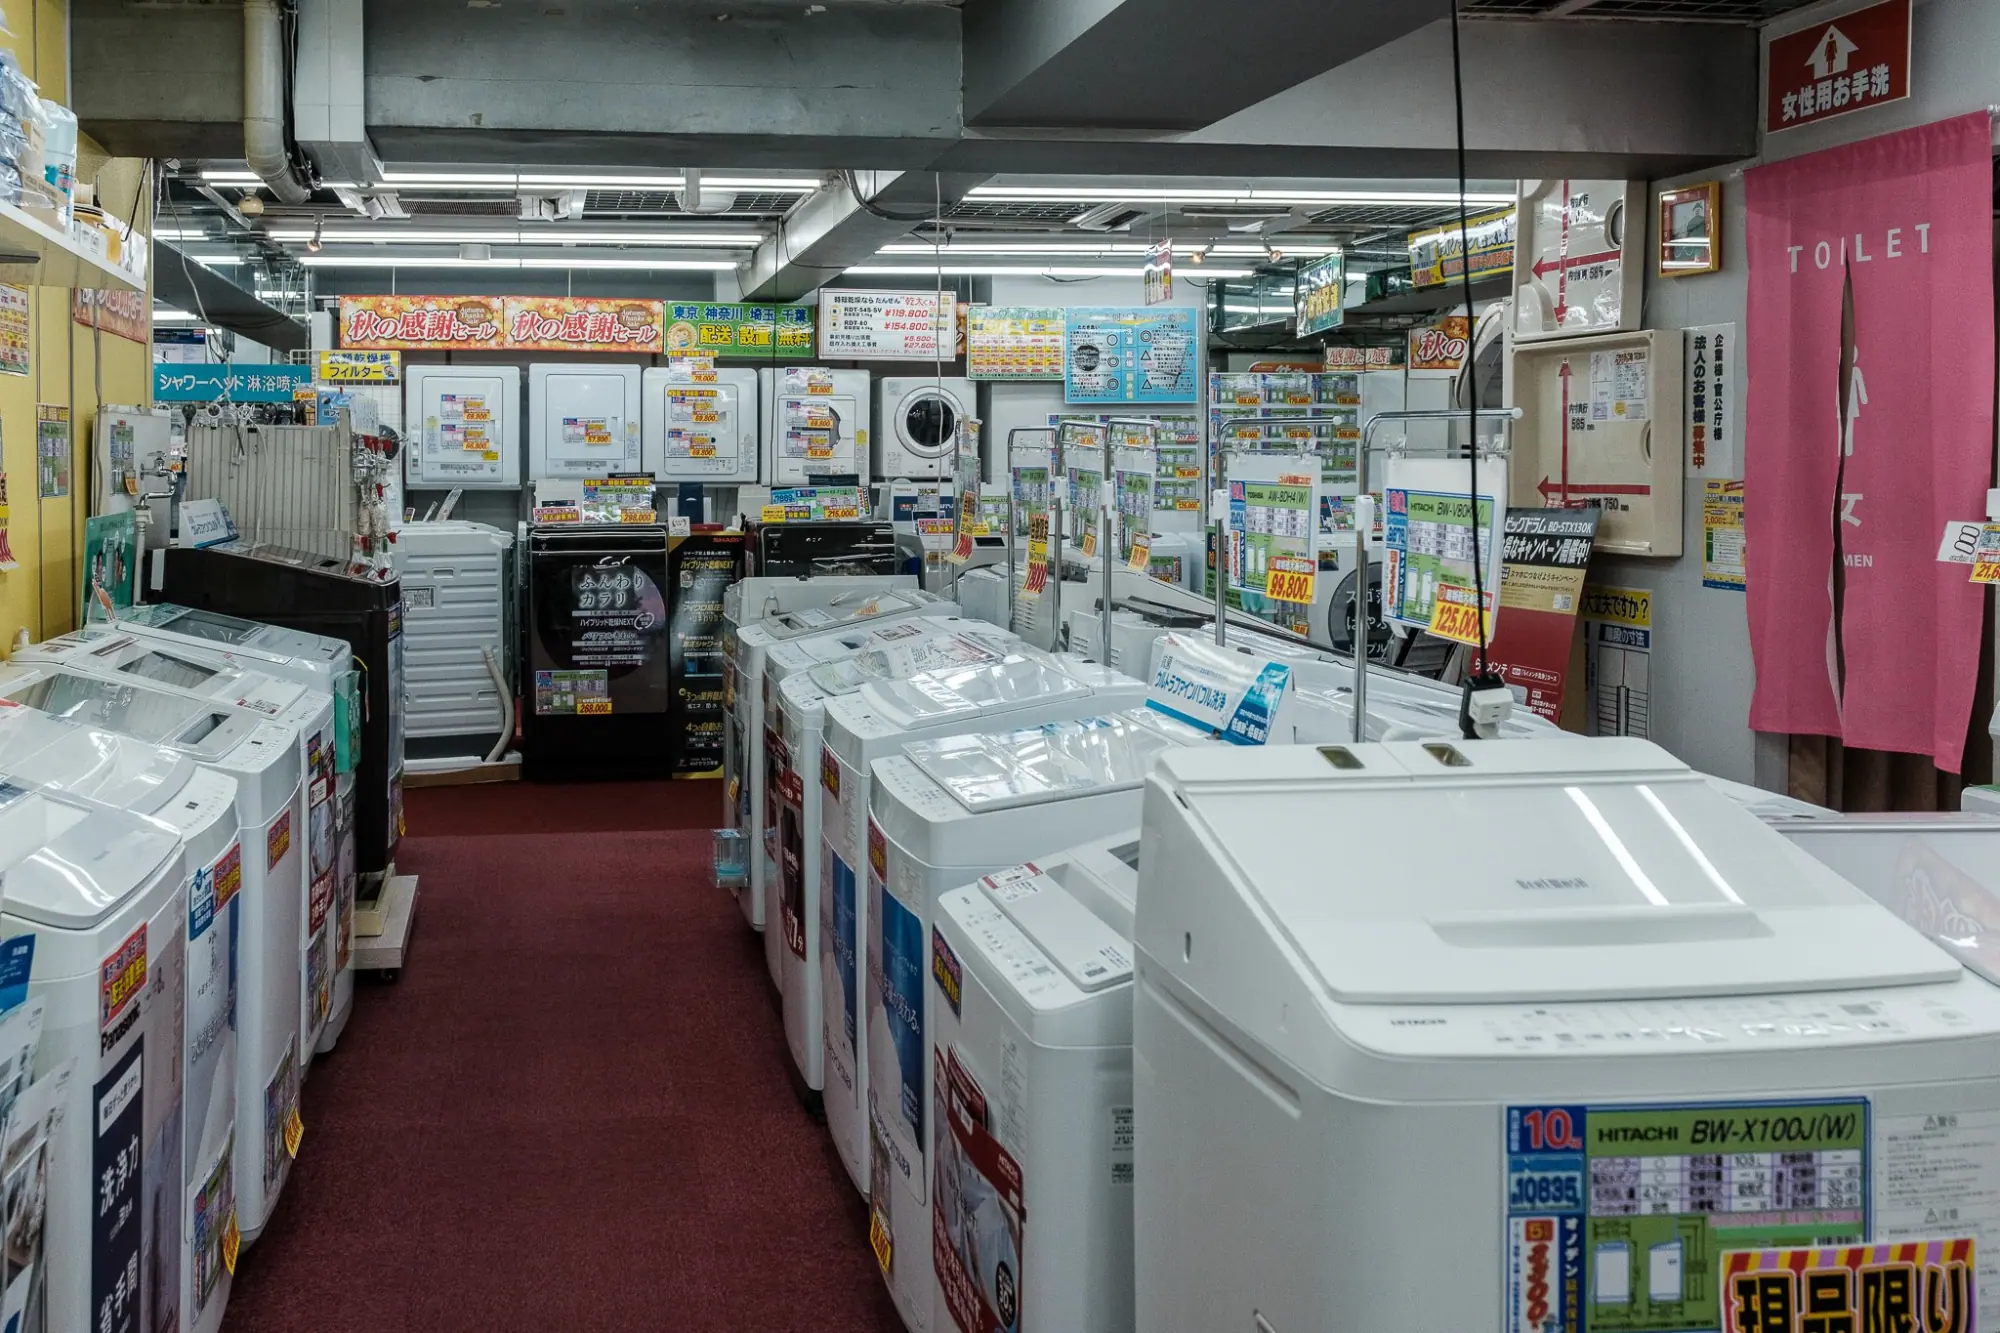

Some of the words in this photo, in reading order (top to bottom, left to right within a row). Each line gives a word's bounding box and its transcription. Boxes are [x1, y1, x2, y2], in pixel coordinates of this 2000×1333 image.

[1781, 63, 1890, 122] 女性用お手洗
[1787, 222, 1932, 274] TOILET
[349, 309, 497, 340] 秋の感謝セール
[513, 310, 656, 343] 秋の感謝セール
[1419, 331, 1467, 361] 秋の
[159, 374, 244, 392] シャワーヘッド
[329, 366, 383, 378] フィルター
[1713, 333, 1724, 442] 企業様・官公庁様
[1692, 335, 1707, 469] 法人のお客様募集中
[1571, 417, 1585, 431] 585
[1246, 491, 1264, 499] TOSHIBA
[1410, 502, 1434, 513] HITACHI
[1604, 497, 1619, 511] 750
[1504, 516, 1546, 534] ビッグドラム
[1547, 520, 1594, 534] BD-STX130K
[1502, 535, 1592, 565] 得なキャンペーン開催中!
[1842, 553, 1873, 567] MEN
[580, 574, 644, 589] ふんわり
[1269, 573, 1309, 600] 99,800
[580, 592, 626, 606] カラリ
[1580, 591, 1649, 619] 大丈夫ですか?
[1474, 657, 1508, 675] らメンテ
[100, 1000, 140, 1058] Panasonic
[1598, 1126, 1679, 1142] HITACHI
[1690, 1111, 1856, 1144] BW-X100J(W)
[100, 1133, 139, 1217] 洗浄力
[1565, 1217, 1579, 1277] オノデン
